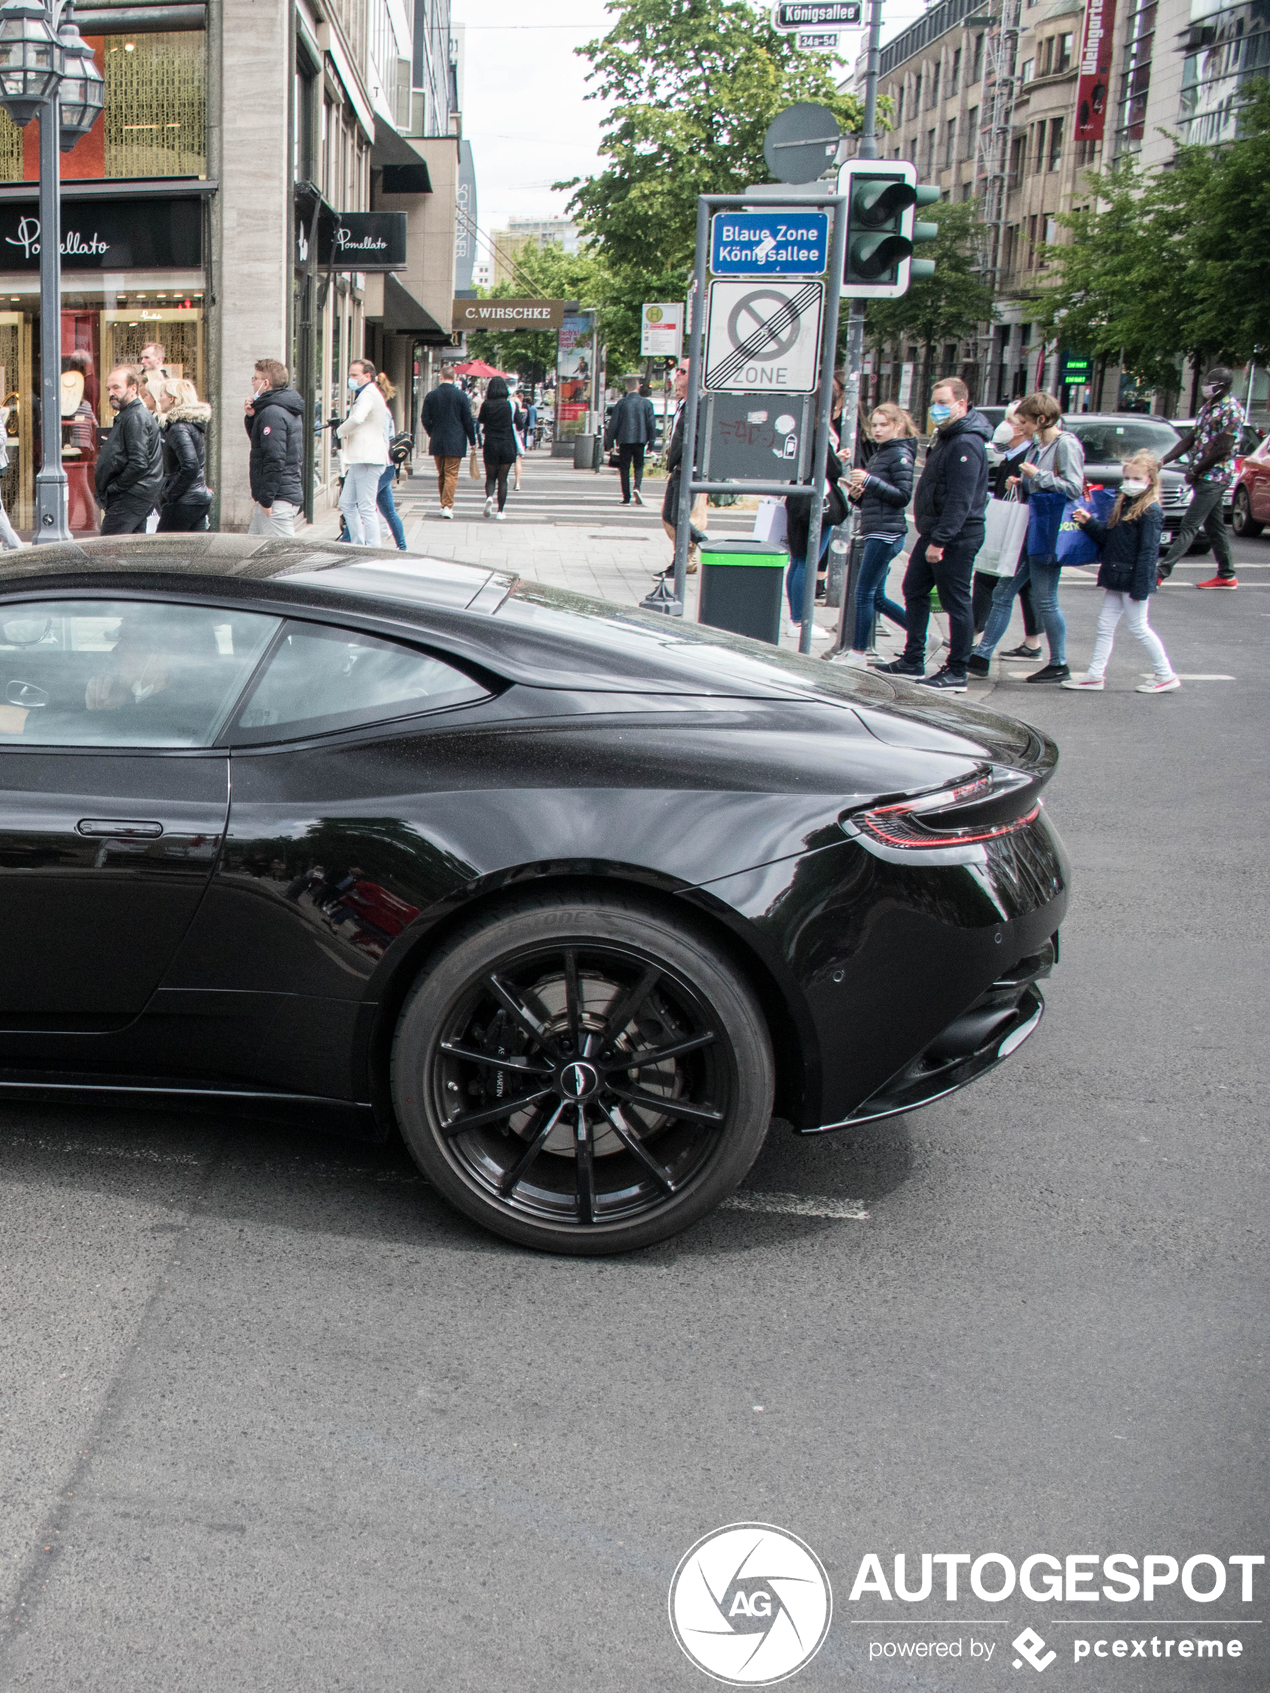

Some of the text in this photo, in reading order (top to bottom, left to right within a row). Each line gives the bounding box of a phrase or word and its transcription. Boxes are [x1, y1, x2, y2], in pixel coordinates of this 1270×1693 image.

[785, 4, 855, 24] Königsallee
[801, 35, 836, 47] 34a-54
[5, 216, 110, 259] Poellato
[332, 228, 388, 251] Pomellato
[722, 225, 818, 242] Blaue Zone
[465, 307, 551, 319] C.WIRSCHKE
[732, 367, 788, 384] ZONE
